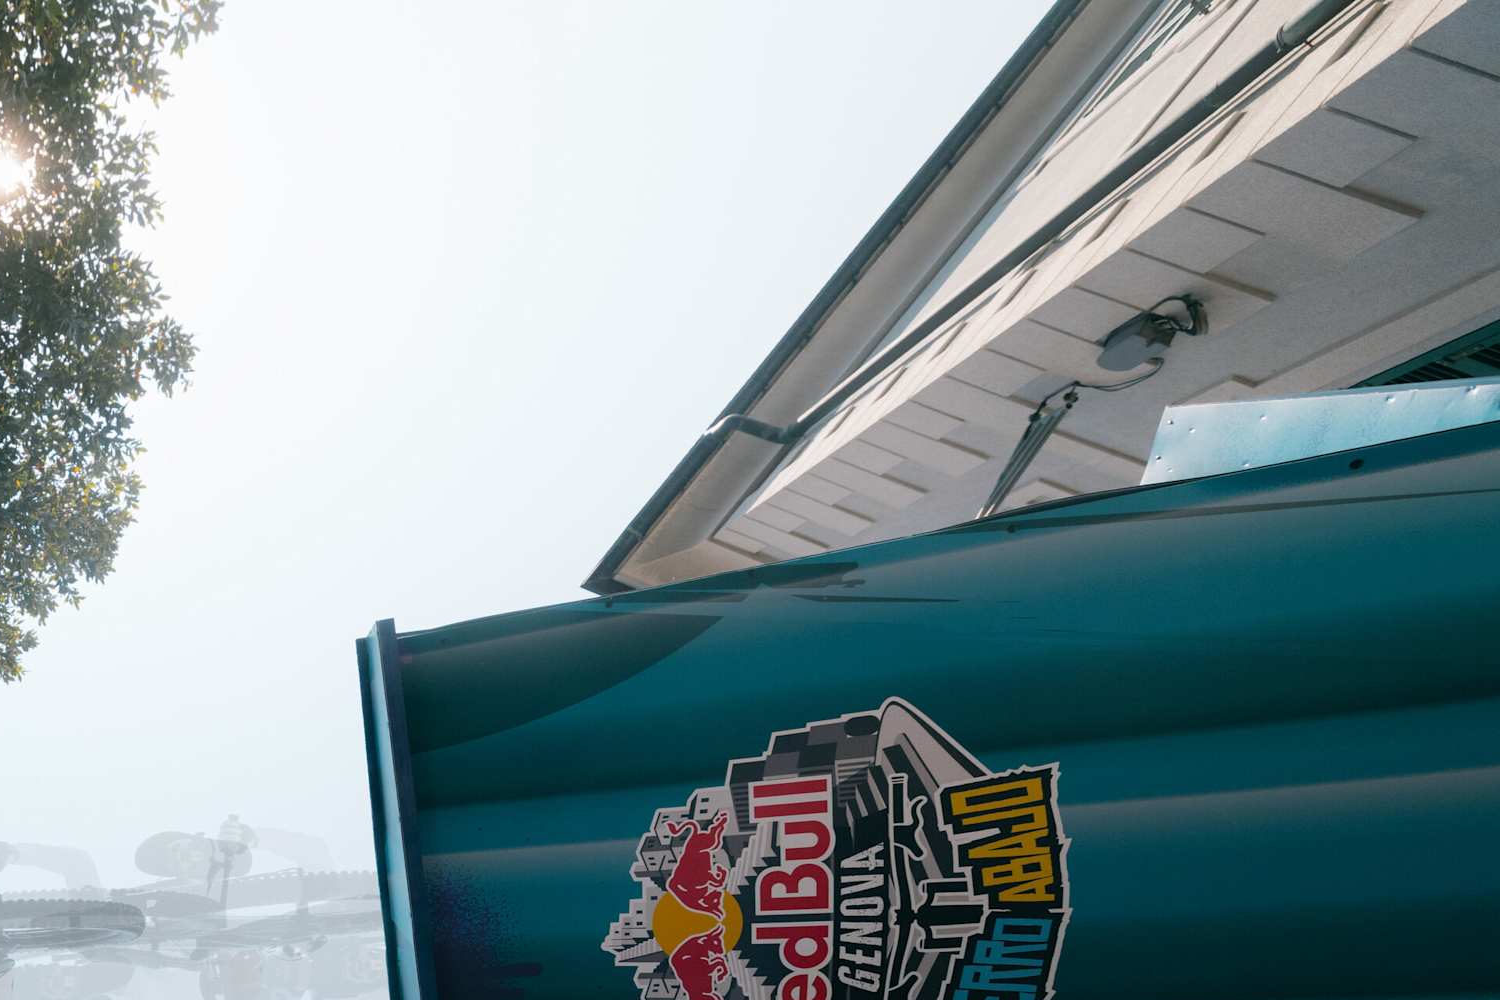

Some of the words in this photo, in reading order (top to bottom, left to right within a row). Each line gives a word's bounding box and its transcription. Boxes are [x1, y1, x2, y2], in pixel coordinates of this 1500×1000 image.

[754, 779, 830, 909] Bull
[950, 778, 1055, 902] ABAJO
[837, 844, 885, 992] GENOVA
